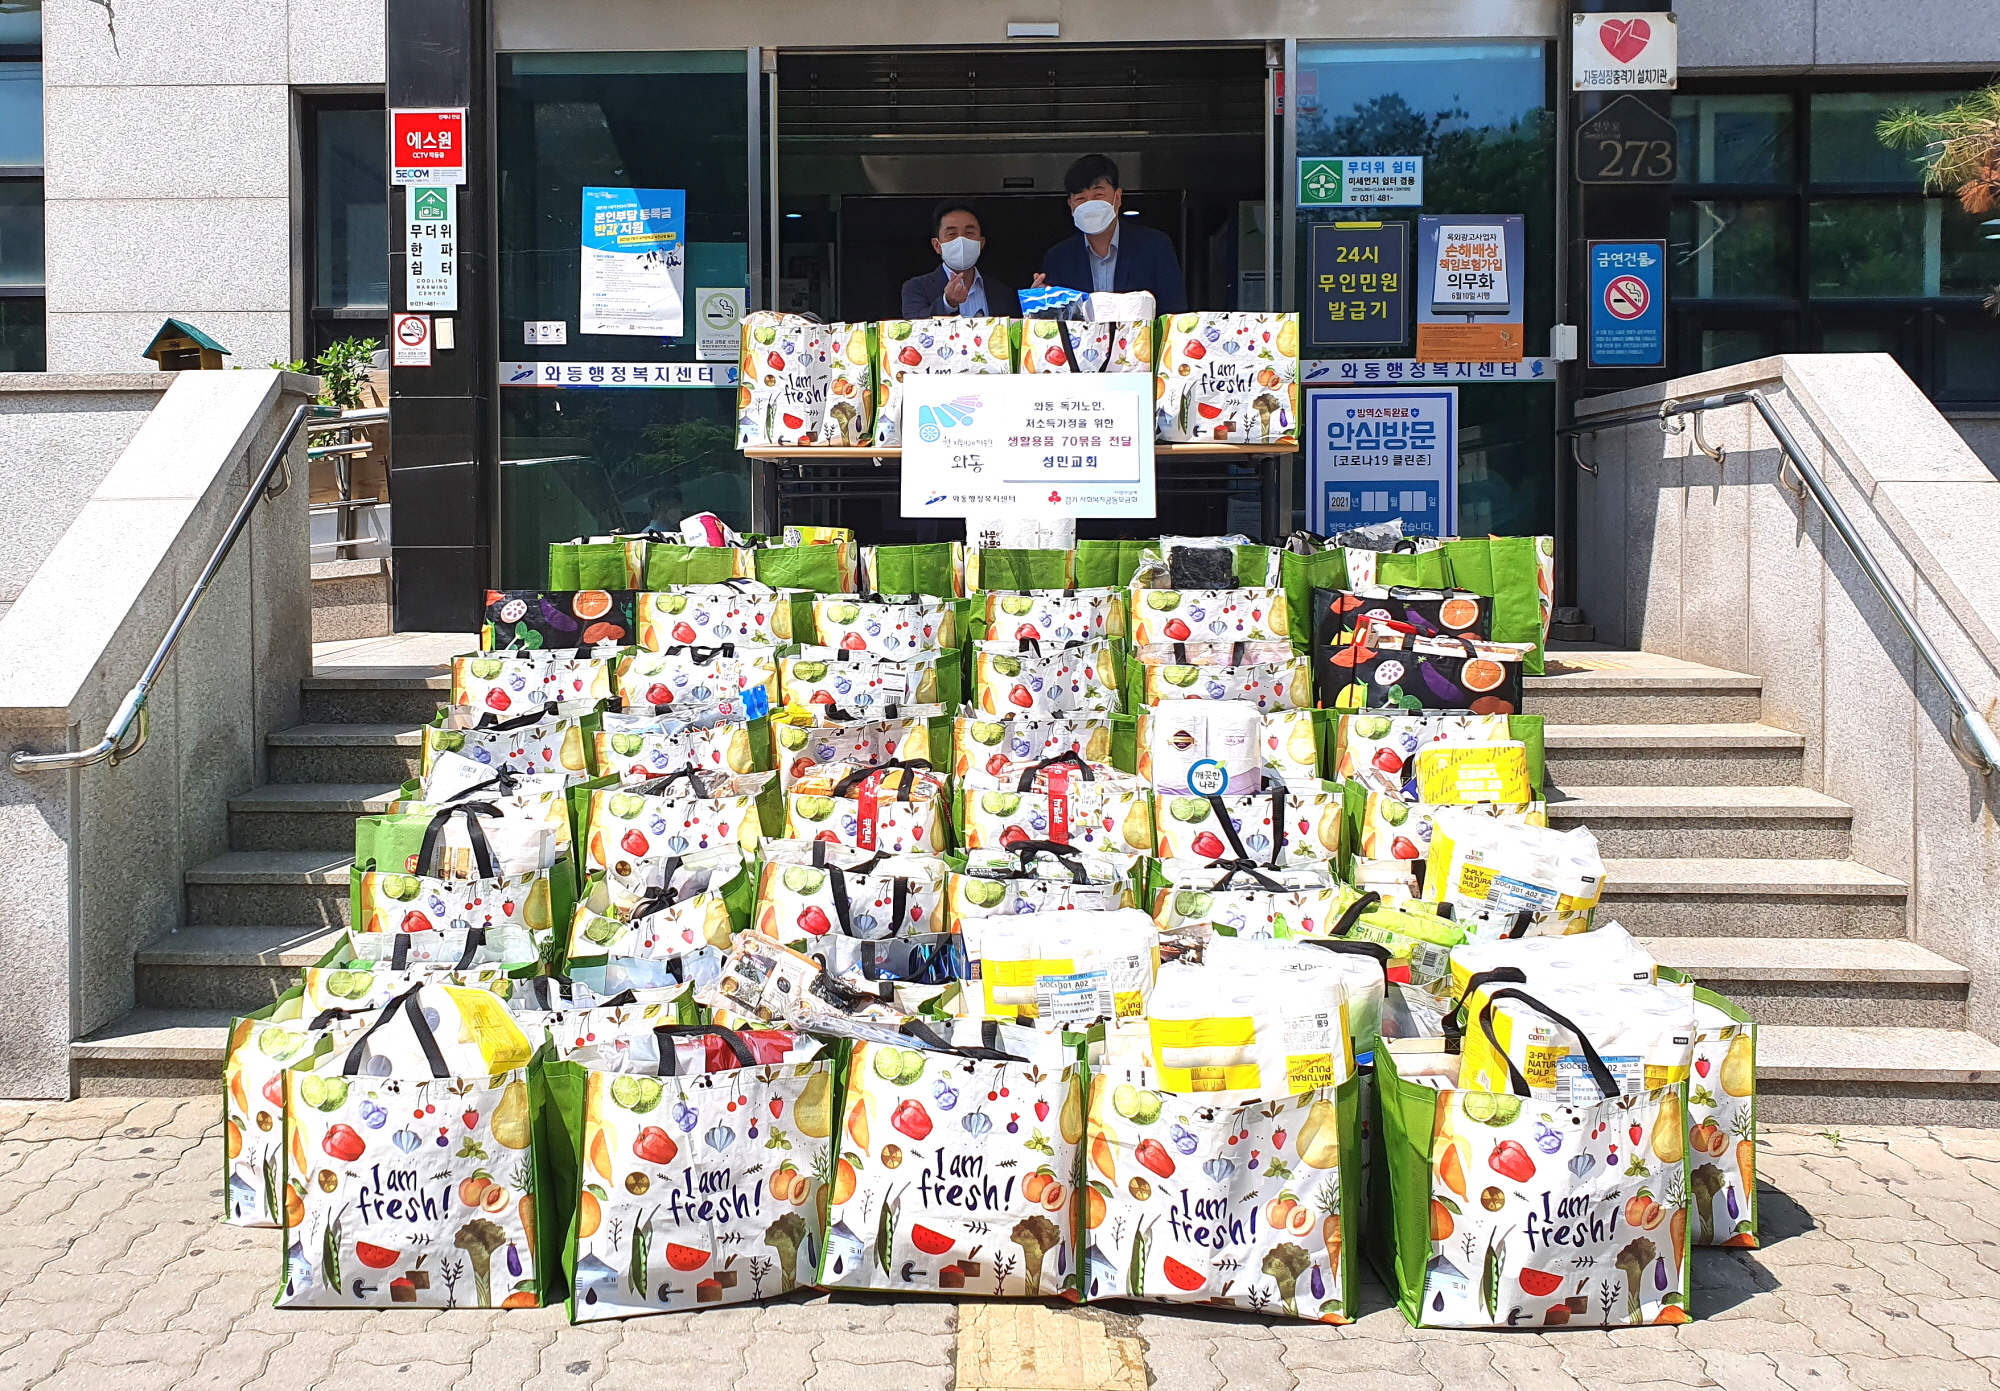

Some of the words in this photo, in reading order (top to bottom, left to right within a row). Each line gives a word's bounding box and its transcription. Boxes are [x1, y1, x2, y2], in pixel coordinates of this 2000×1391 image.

[1584, 70, 1635, 84] 자동심장충격기
[1638, 69, 1667, 84] 설치기관
[406, 132, 452, 149] 에스원
[1598, 140, 1672, 177] 273
[396, 170, 429, 178] SECOM
[1348, 161, 1384, 174] 무더위
[1392, 161, 1415, 173] 쉼터
[1348, 177, 1379, 185] 미세먼지
[1382, 177, 1396, 185] 쉼터
[1400, 177, 1415, 185] 겸용
[595, 210, 637, 223] 본인부담
[410, 224, 452, 240] 무더위
[620, 221, 644, 234] 지원
[1336, 246, 1380, 264] 24시
[1445, 243, 1498, 258] 손해배상
[1439, 258, 1502, 271] 책임보험가입
[1597, 252, 1650, 267] 금연건물
[1318, 273, 1398, 293] 무인민원
[1447, 273, 1495, 290] 의무화
[1328, 301, 1387, 321] 발급기
[545, 366, 713, 382] 와동행정복지센터
[1209, 362, 1216, 378] I
[1218, 364, 1236, 377] am
[1340, 362, 1517, 379] 와동행정복지센터
[788, 373, 795, 390] I
[796, 374, 812, 388] am
[1202, 374, 1253, 395] fresh!
[784, 383, 827, 404] fresh!
[1034, 401, 1054, 412] 와동
[1357, 408, 1409, 418] 방역소독완료
[1025, 418, 1087, 428] 저소득가정을
[1094, 418, 1114, 428] 위한
[1008, 436, 1054, 447] 생활용품
[1062, 436, 1102, 447] 70묶음
[1109, 436, 1132, 447] 전달
[1327, 420, 1436, 450] 안심방문
[951, 454, 984, 473] 와동
[1042, 455, 1098, 468] 성민교회
[953, 494, 1016, 504] 와동행정복지센터
[1195, 771, 1220, 780] 깨끗한
[1200, 781, 1215, 789] 나라
[1462, 881, 1480, 889] PULP
[1075, 980, 1089, 988] A02
[1290, 1074, 1332, 1082] NATURAL
[1527, 1068, 1549, 1076] PULP
[935, 1146, 946, 1180] I
[950, 1154, 983, 1178] am
[371, 1163, 383, 1196] I
[386, 1169, 417, 1192] am
[683, 1167, 696, 1199] I
[698, 1167, 730, 1194] am
[917, 1168, 1015, 1212] fresh!
[356, 1184, 451, 1225] fresh!
[667, 1179, 762, 1226] fresh!
[1180, 1188, 1191, 1220] I
[1194, 1196, 1227, 1219] am
[1541, 1191, 1553, 1224] I
[1557, 1194, 1590, 1219] am
[1167, 1204, 1258, 1249] fresh!
[1522, 1205, 1619, 1252] fresh!
